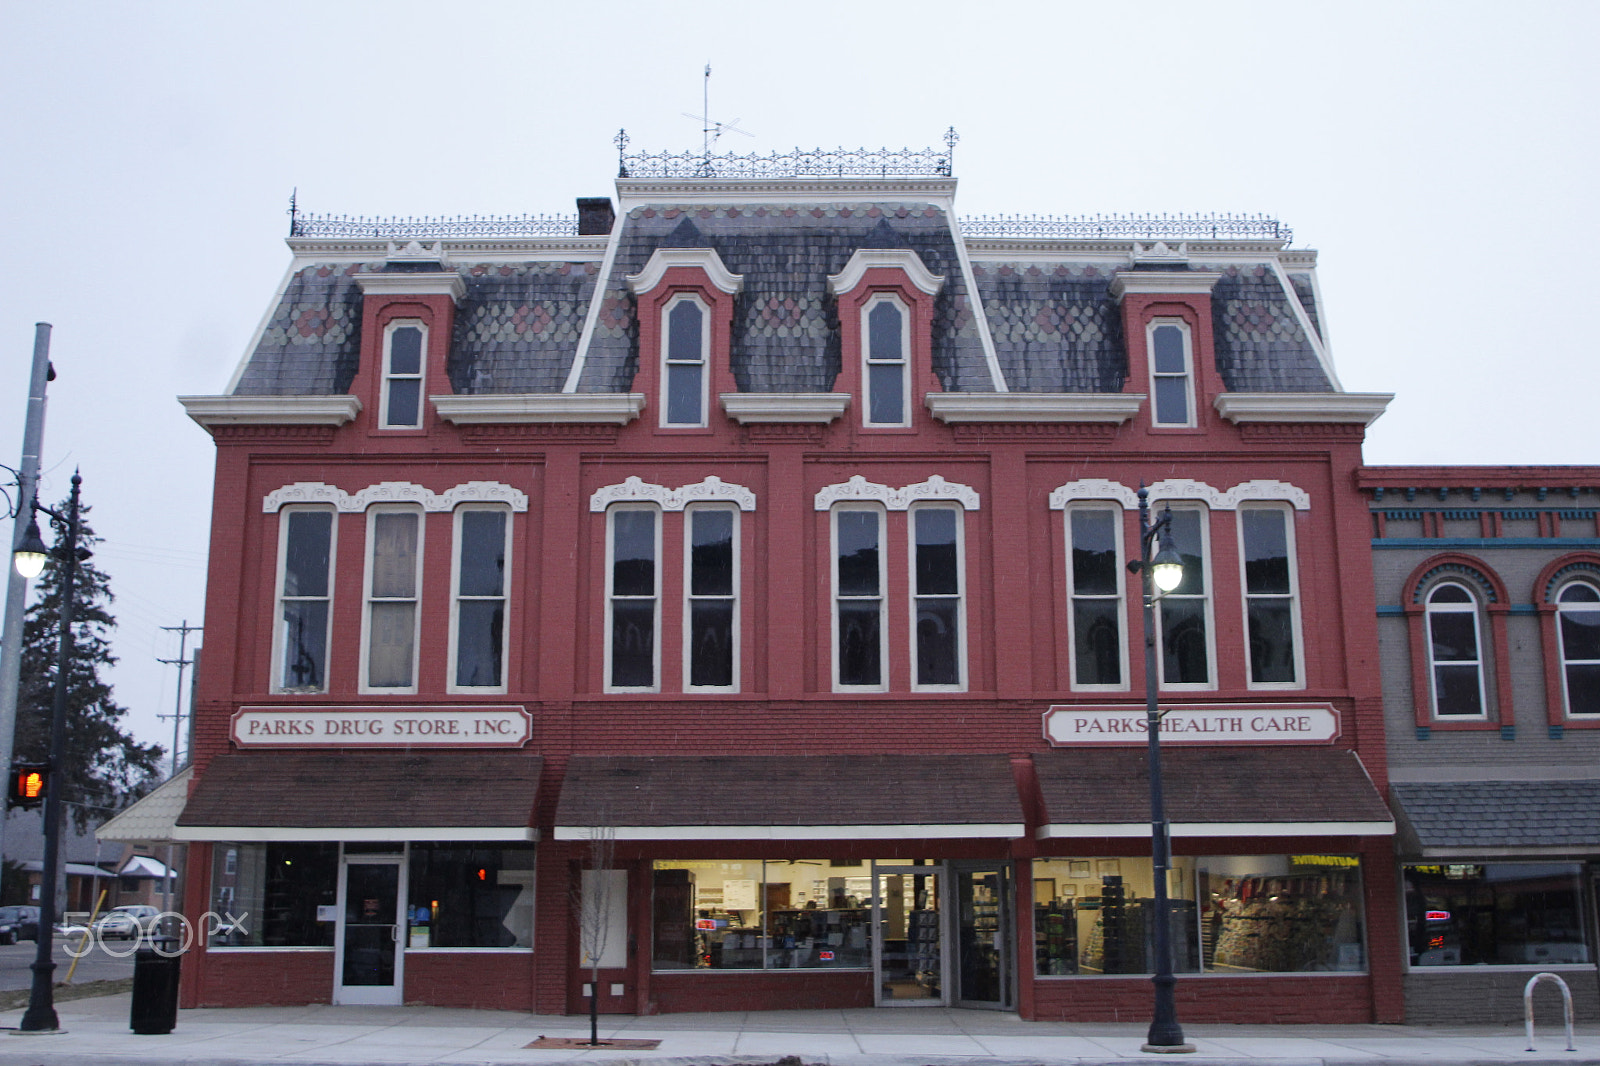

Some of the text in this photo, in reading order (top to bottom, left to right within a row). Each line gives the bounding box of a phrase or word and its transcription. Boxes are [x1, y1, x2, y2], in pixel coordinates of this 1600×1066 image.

[248, 719, 314, 736] PARKS
[324, 719, 384, 735] DRUG
[474, 719, 518, 735] INC.
[1075, 716, 1312, 733] PARKS HEALTH CARE
